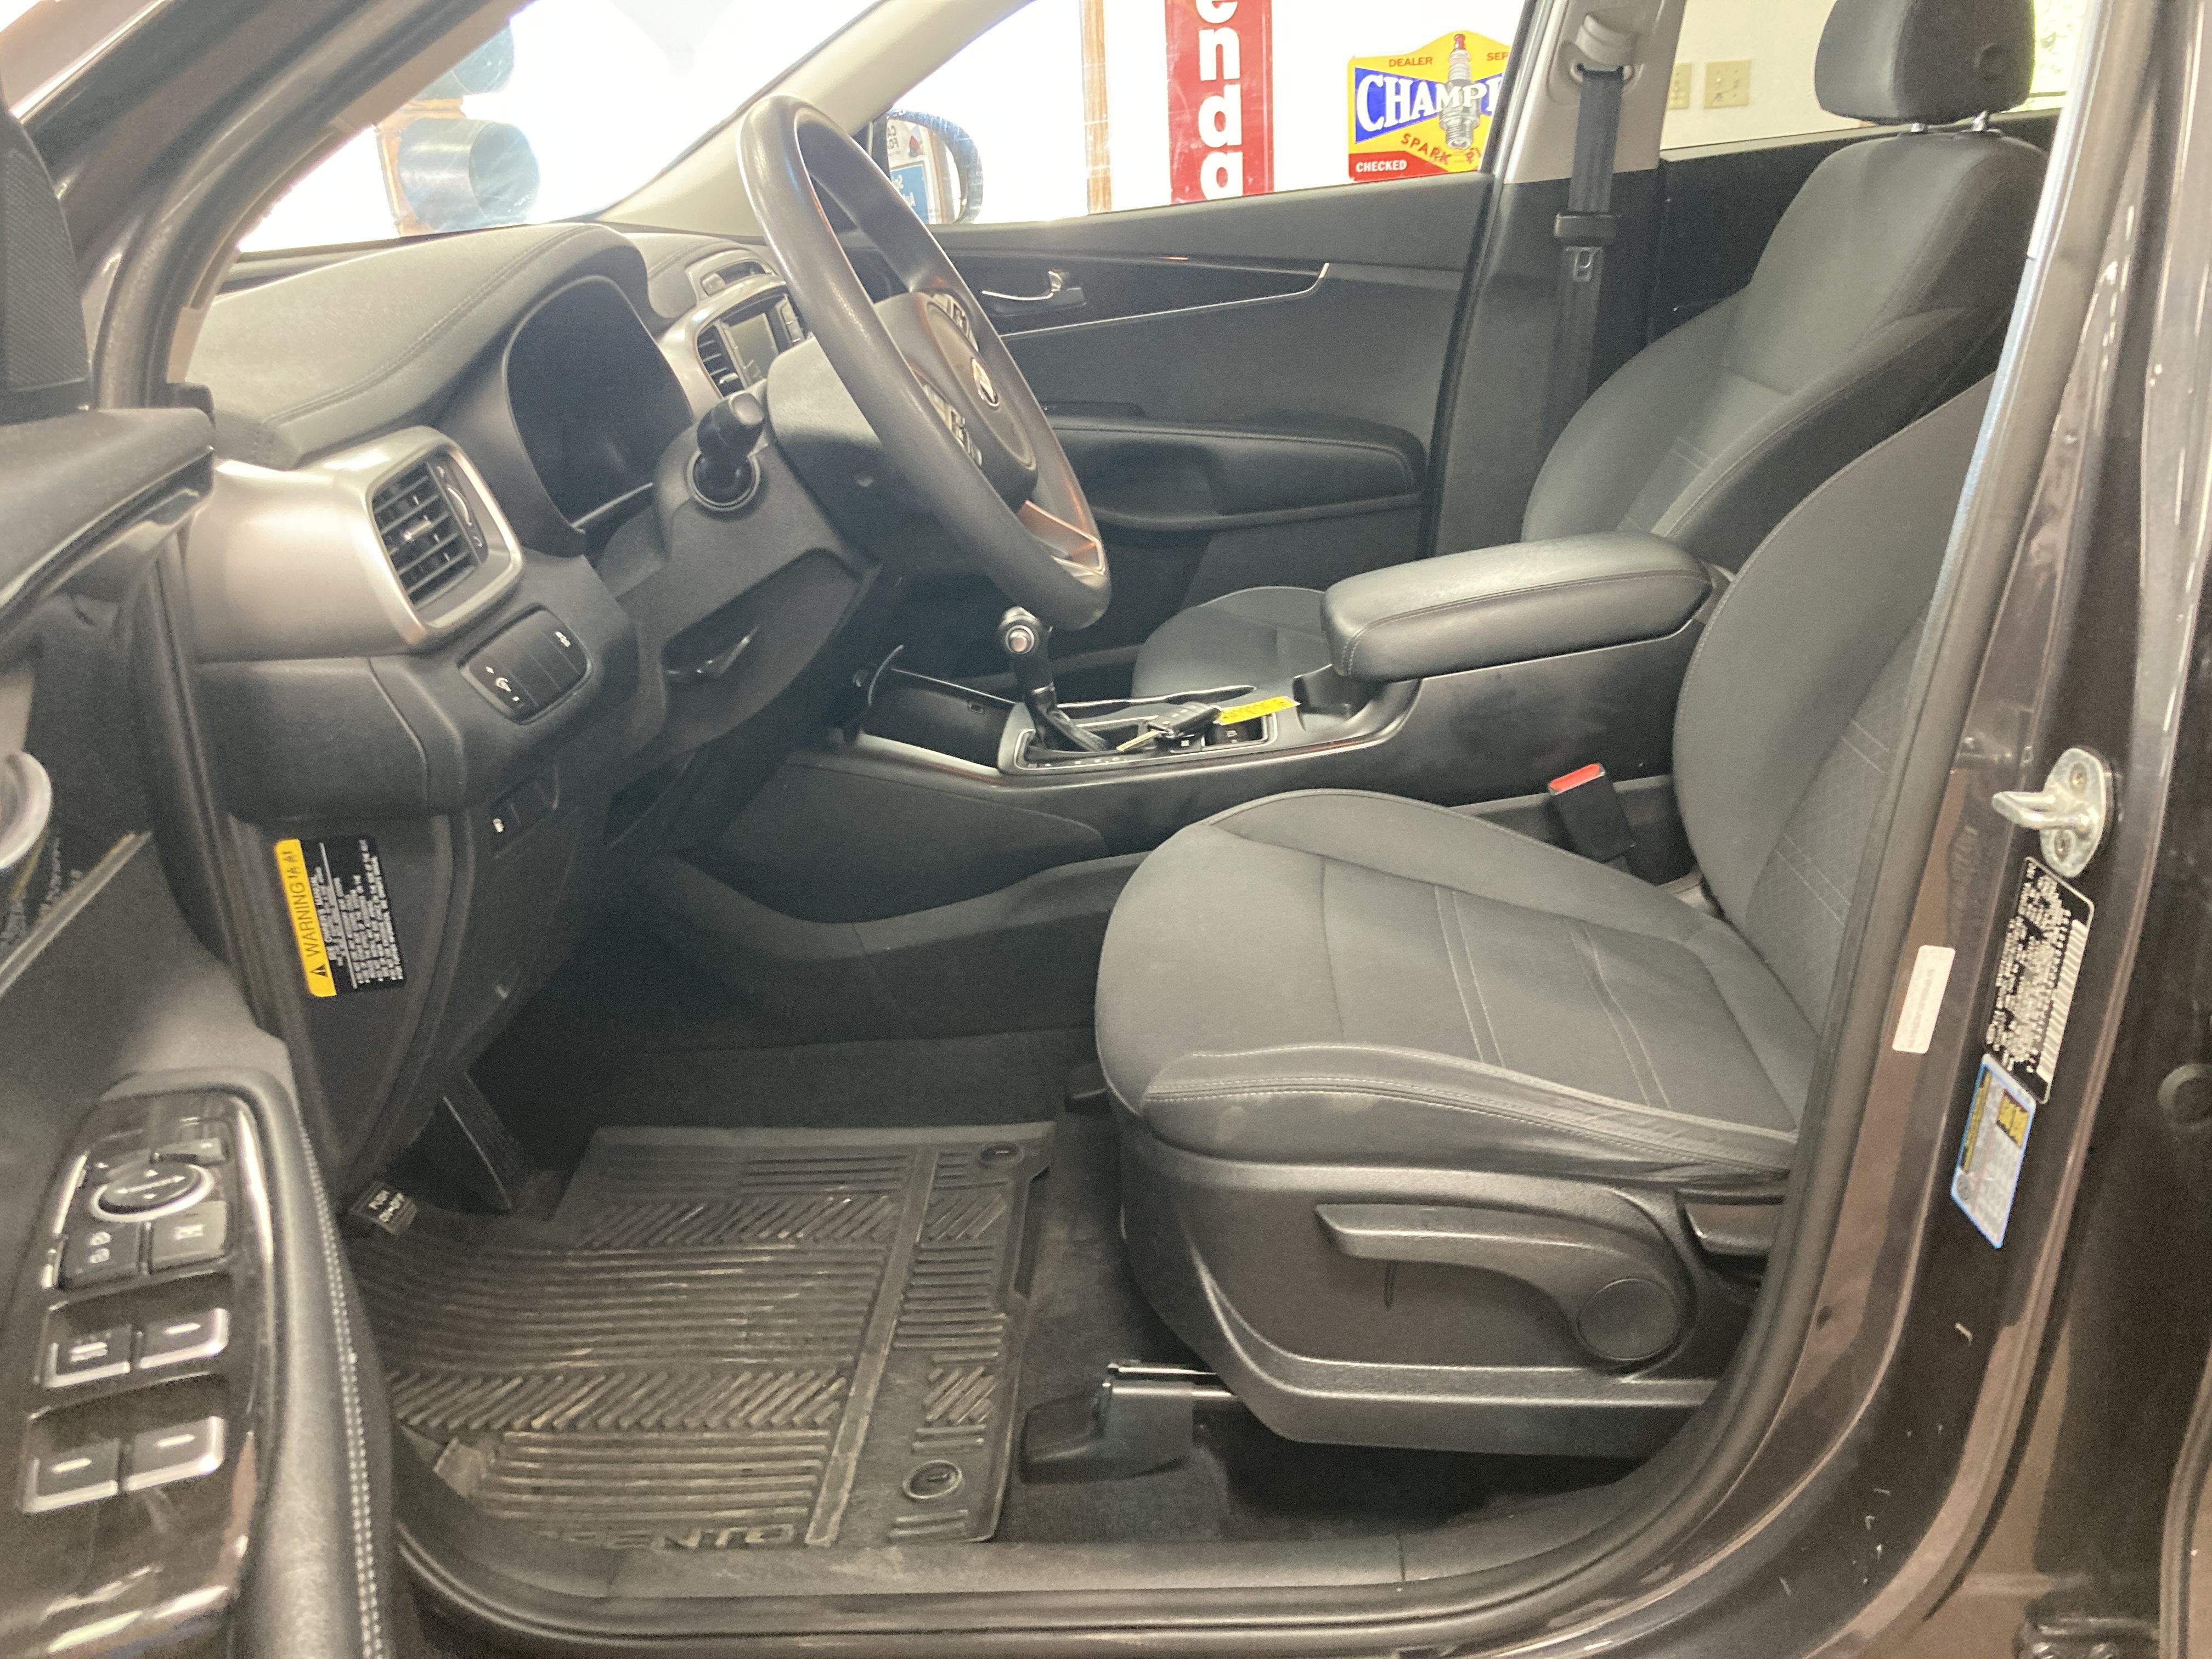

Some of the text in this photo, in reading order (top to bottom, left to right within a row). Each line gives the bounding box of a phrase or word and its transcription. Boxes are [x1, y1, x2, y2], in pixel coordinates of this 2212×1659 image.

[1389, 57, 1432, 67] DEALER
[1401, 133, 1452, 165] SPARK
[1356, 160, 1407, 173] CHECKED
[289, 882, 321, 957] WARNING
